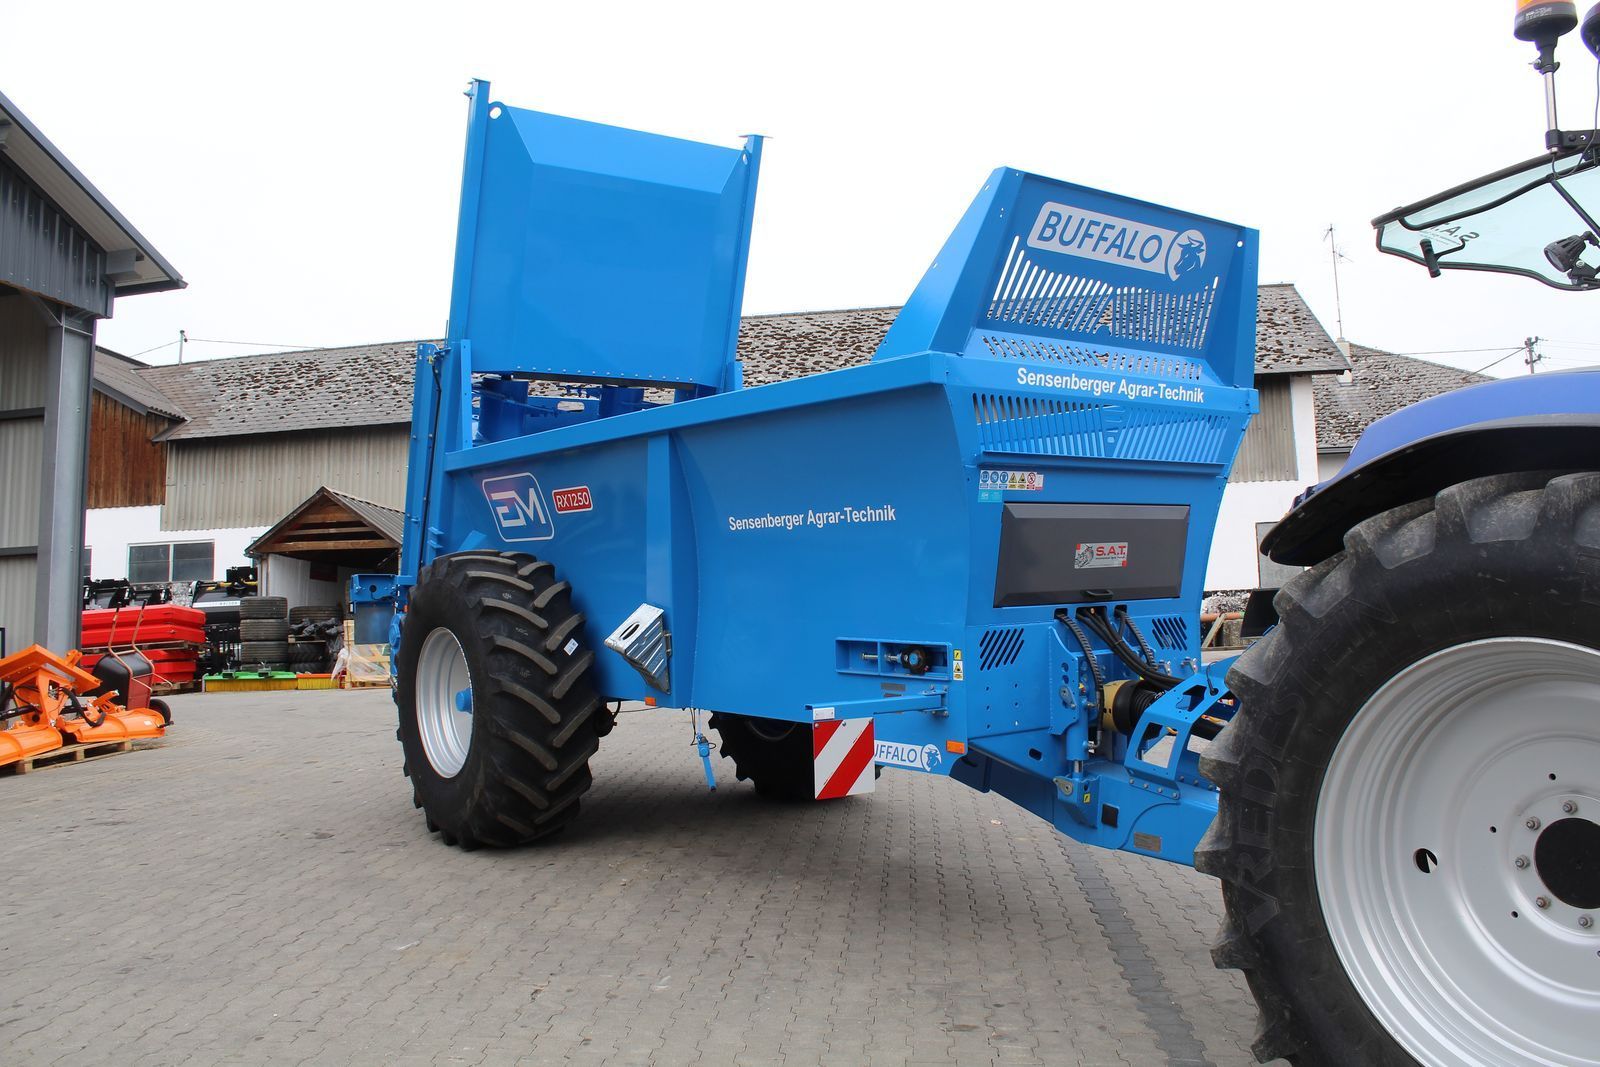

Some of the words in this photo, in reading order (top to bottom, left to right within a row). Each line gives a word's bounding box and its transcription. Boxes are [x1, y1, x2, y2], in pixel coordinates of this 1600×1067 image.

[1036, 210, 1163, 264] BUFFALO
[1016, 367, 1116, 396] Sensenberger
[1118, 378, 1205, 404] Agrar-Technik
[556, 492, 590, 508] RX1250
[728, 512, 804, 531] Sensenberger
[806, 504, 897, 528] Agrar-Technik
[874, 743, 918, 763] UFFALO
